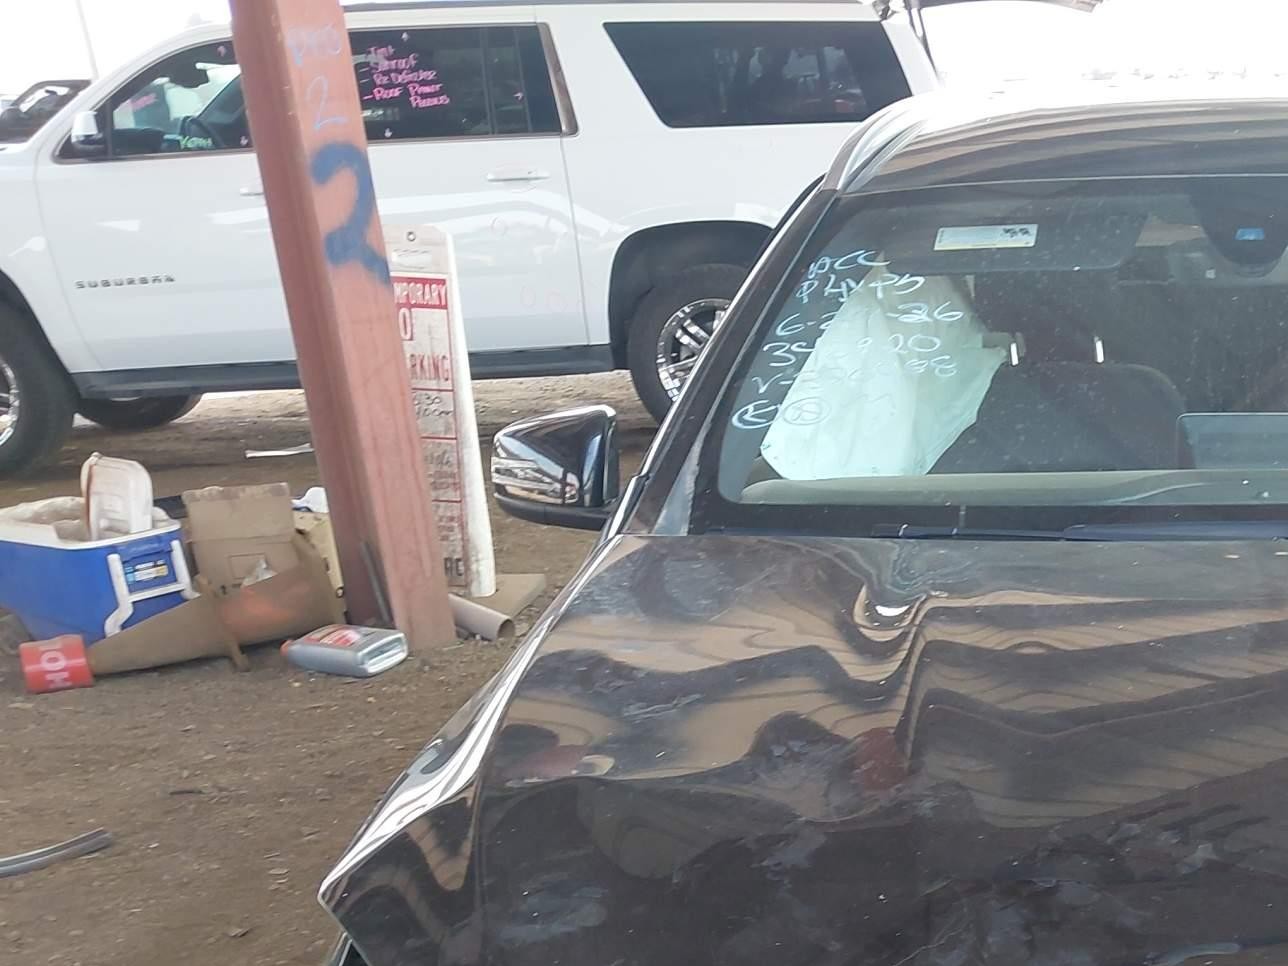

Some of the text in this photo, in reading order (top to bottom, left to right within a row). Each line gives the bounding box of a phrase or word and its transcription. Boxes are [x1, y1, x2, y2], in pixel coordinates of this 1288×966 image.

[311, 141, 391, 286] 2
[75, 274, 175, 290] SUBURBAN
[392, 282, 448, 306] MPORARY
[408, 353, 450, 382] RKING
